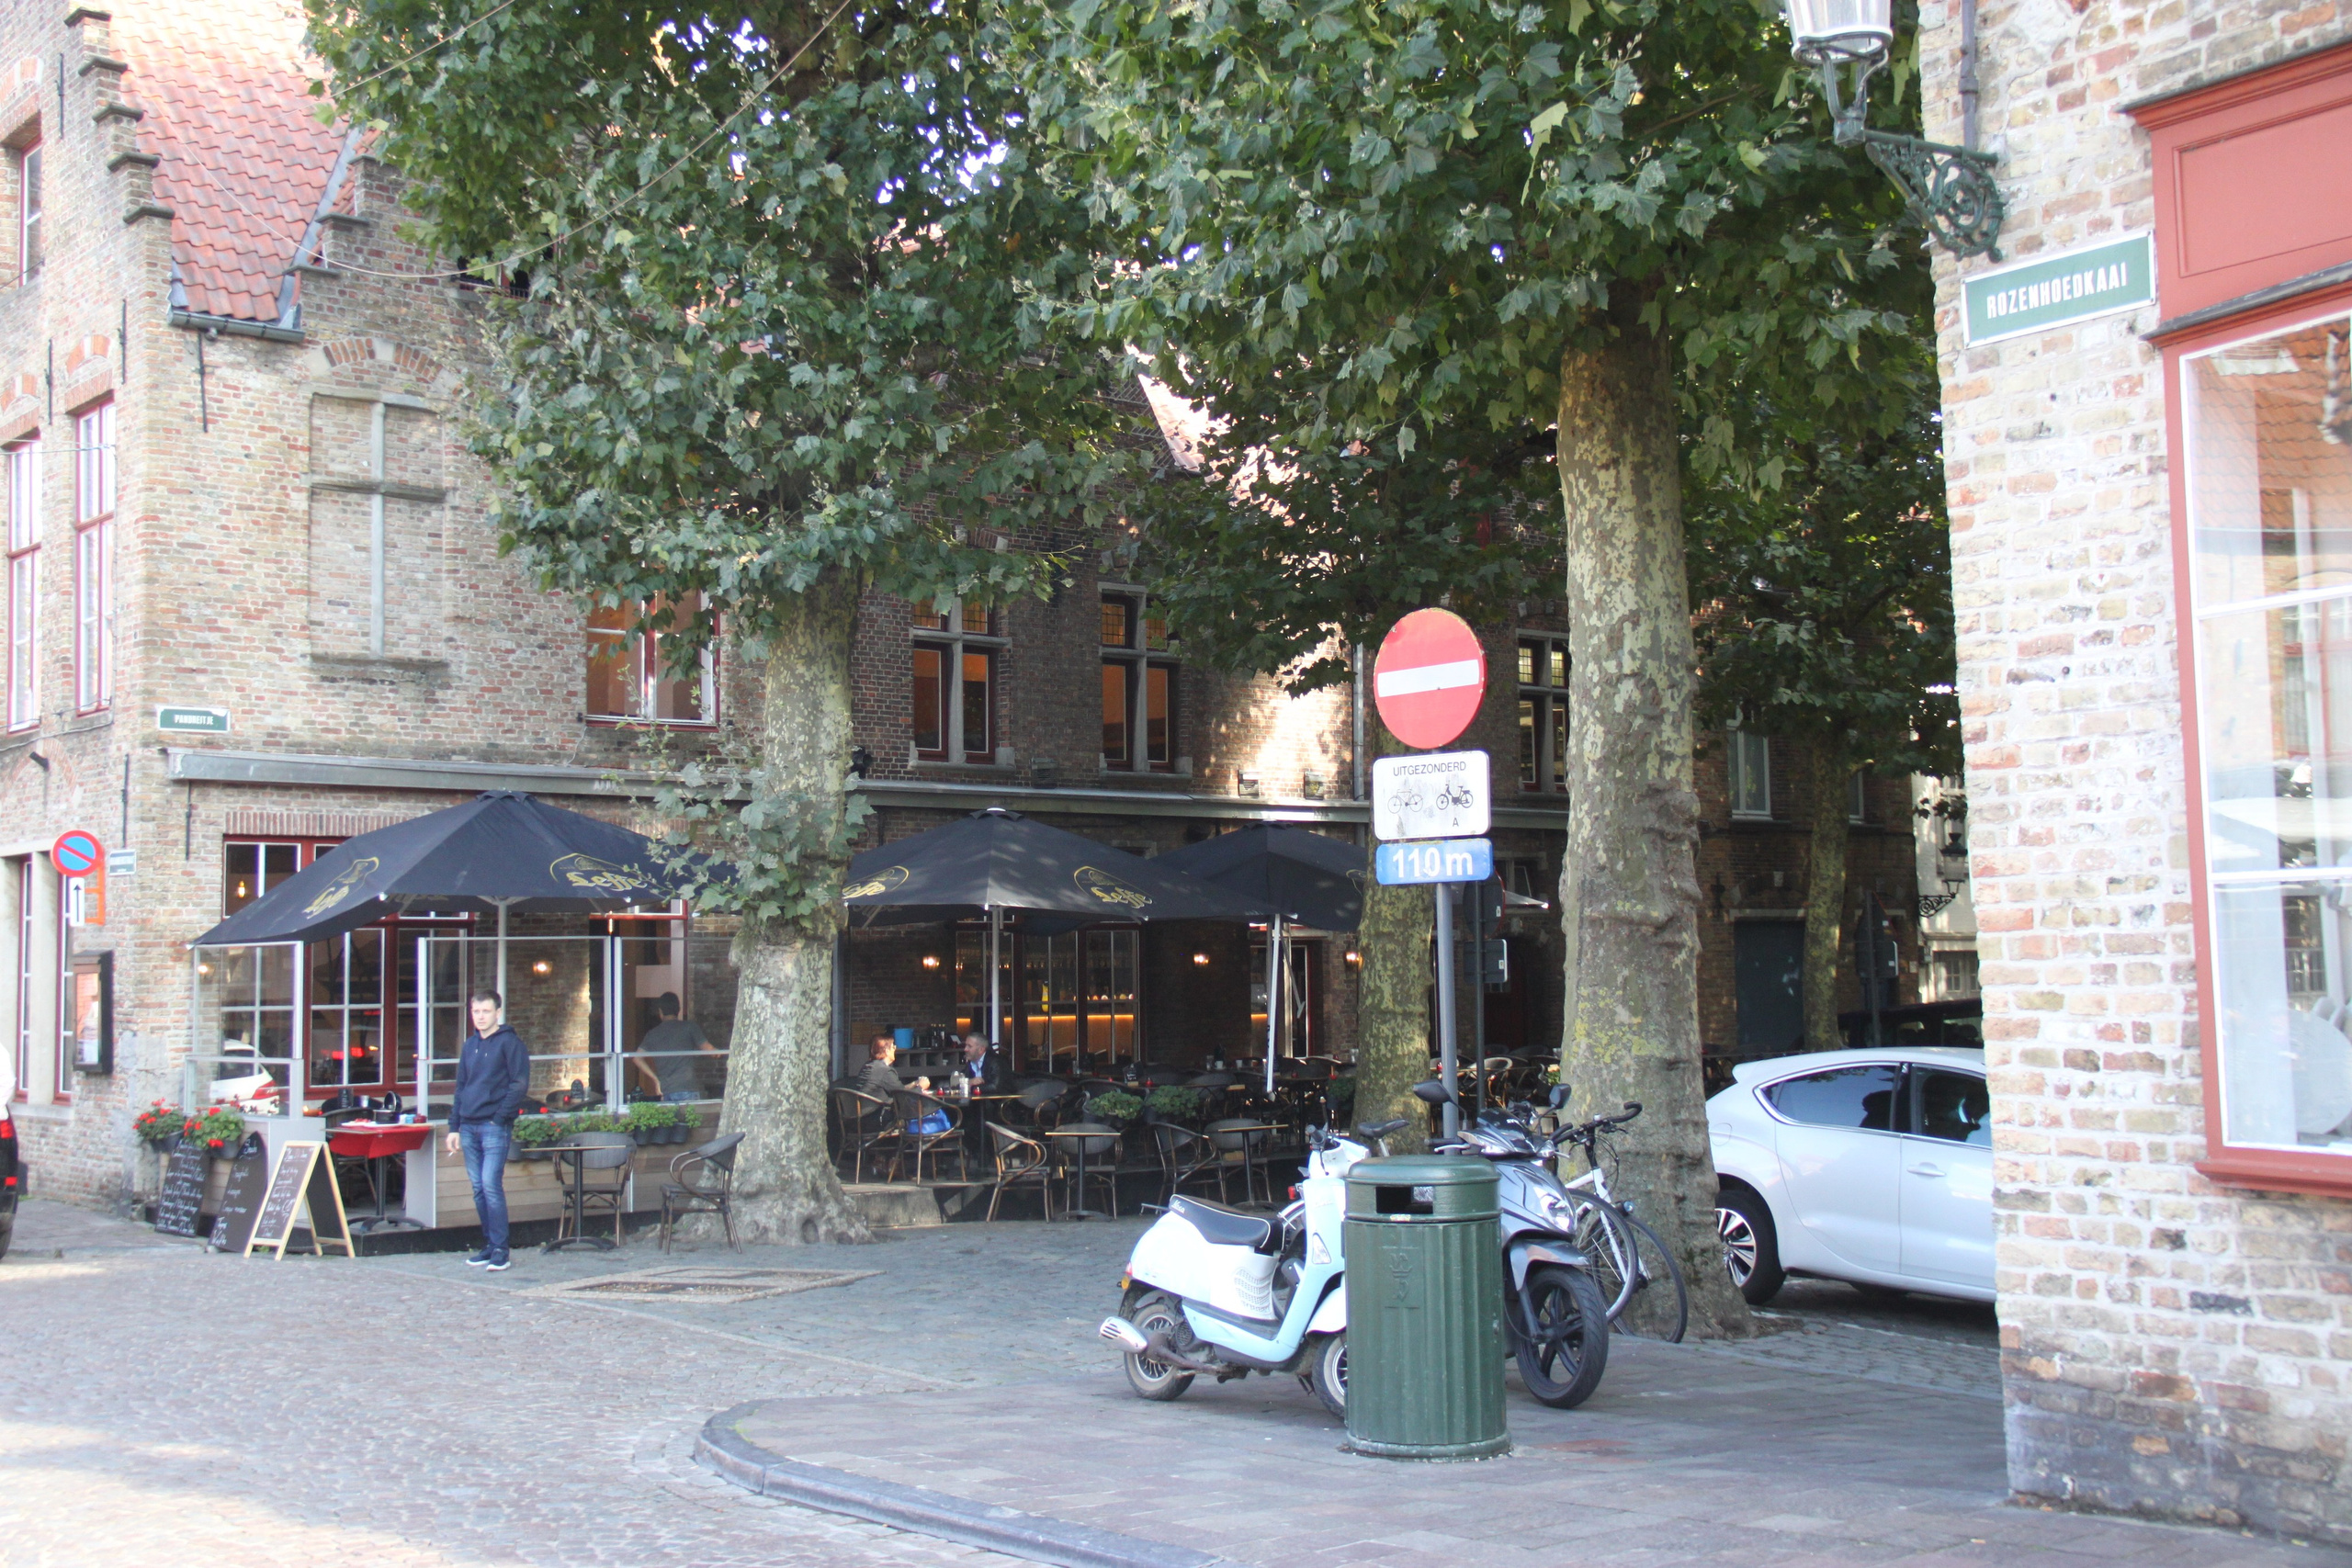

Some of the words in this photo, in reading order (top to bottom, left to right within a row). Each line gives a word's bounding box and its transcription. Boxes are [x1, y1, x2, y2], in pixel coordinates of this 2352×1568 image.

[1986, 261, 2129, 319] ROZENHOEDKAAI
[1393, 761, 1466, 776] UITGEZONDERD
[1452, 817, 1459, 828] A
[1392, 847, 1441, 878] 110
[1445, 852, 1474, 876] m
[566, 871, 648, 892] Leffe
[1091, 886, 1153, 909] Leffe
